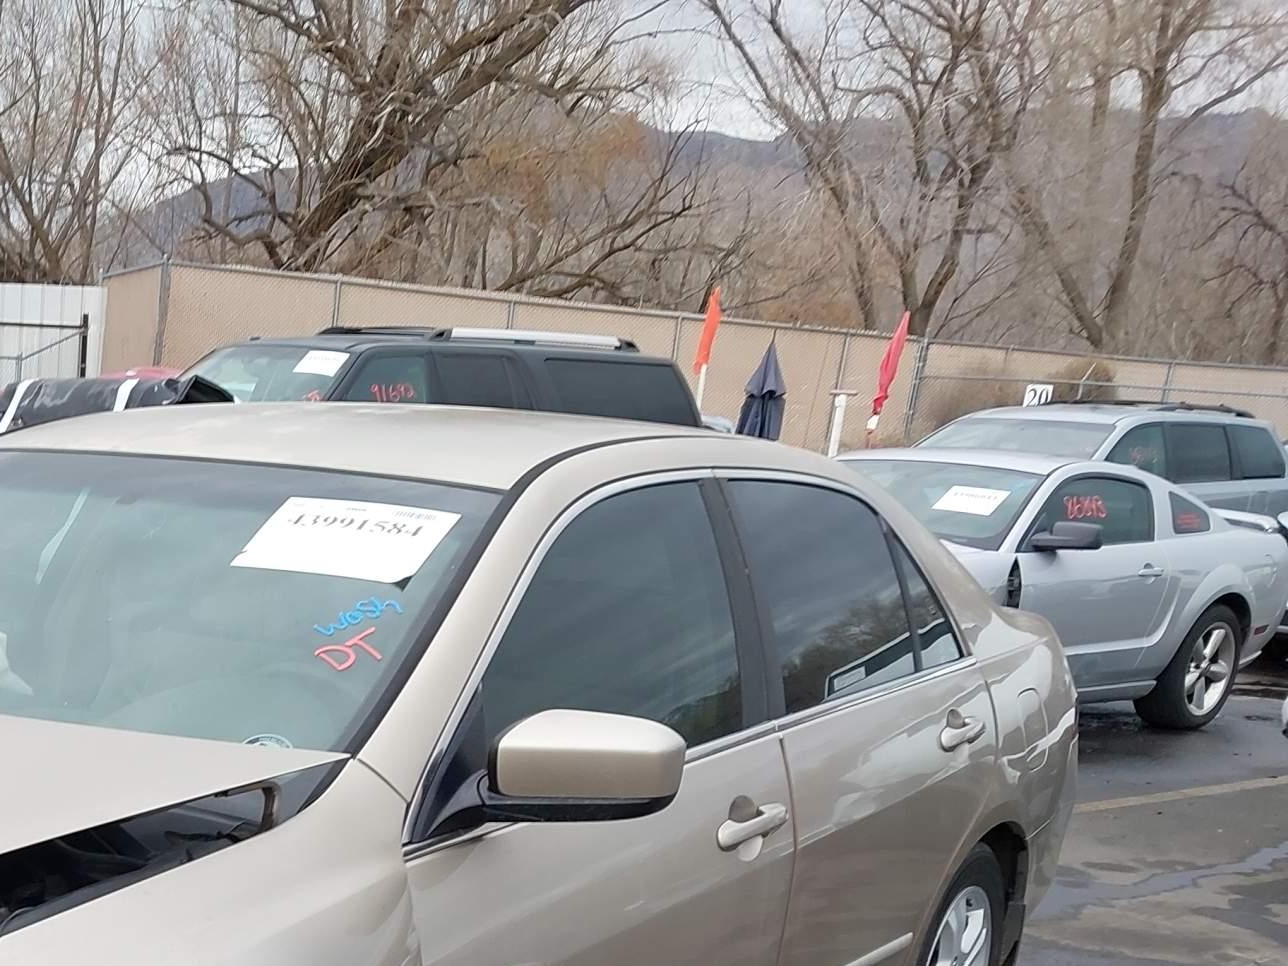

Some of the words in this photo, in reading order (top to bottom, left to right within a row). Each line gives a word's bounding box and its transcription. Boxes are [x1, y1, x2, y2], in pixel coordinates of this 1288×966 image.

[1026, 388, 1049, 407] 20
[287, 512, 425, 537] 43991584
[314, 626, 383, 671] DT
